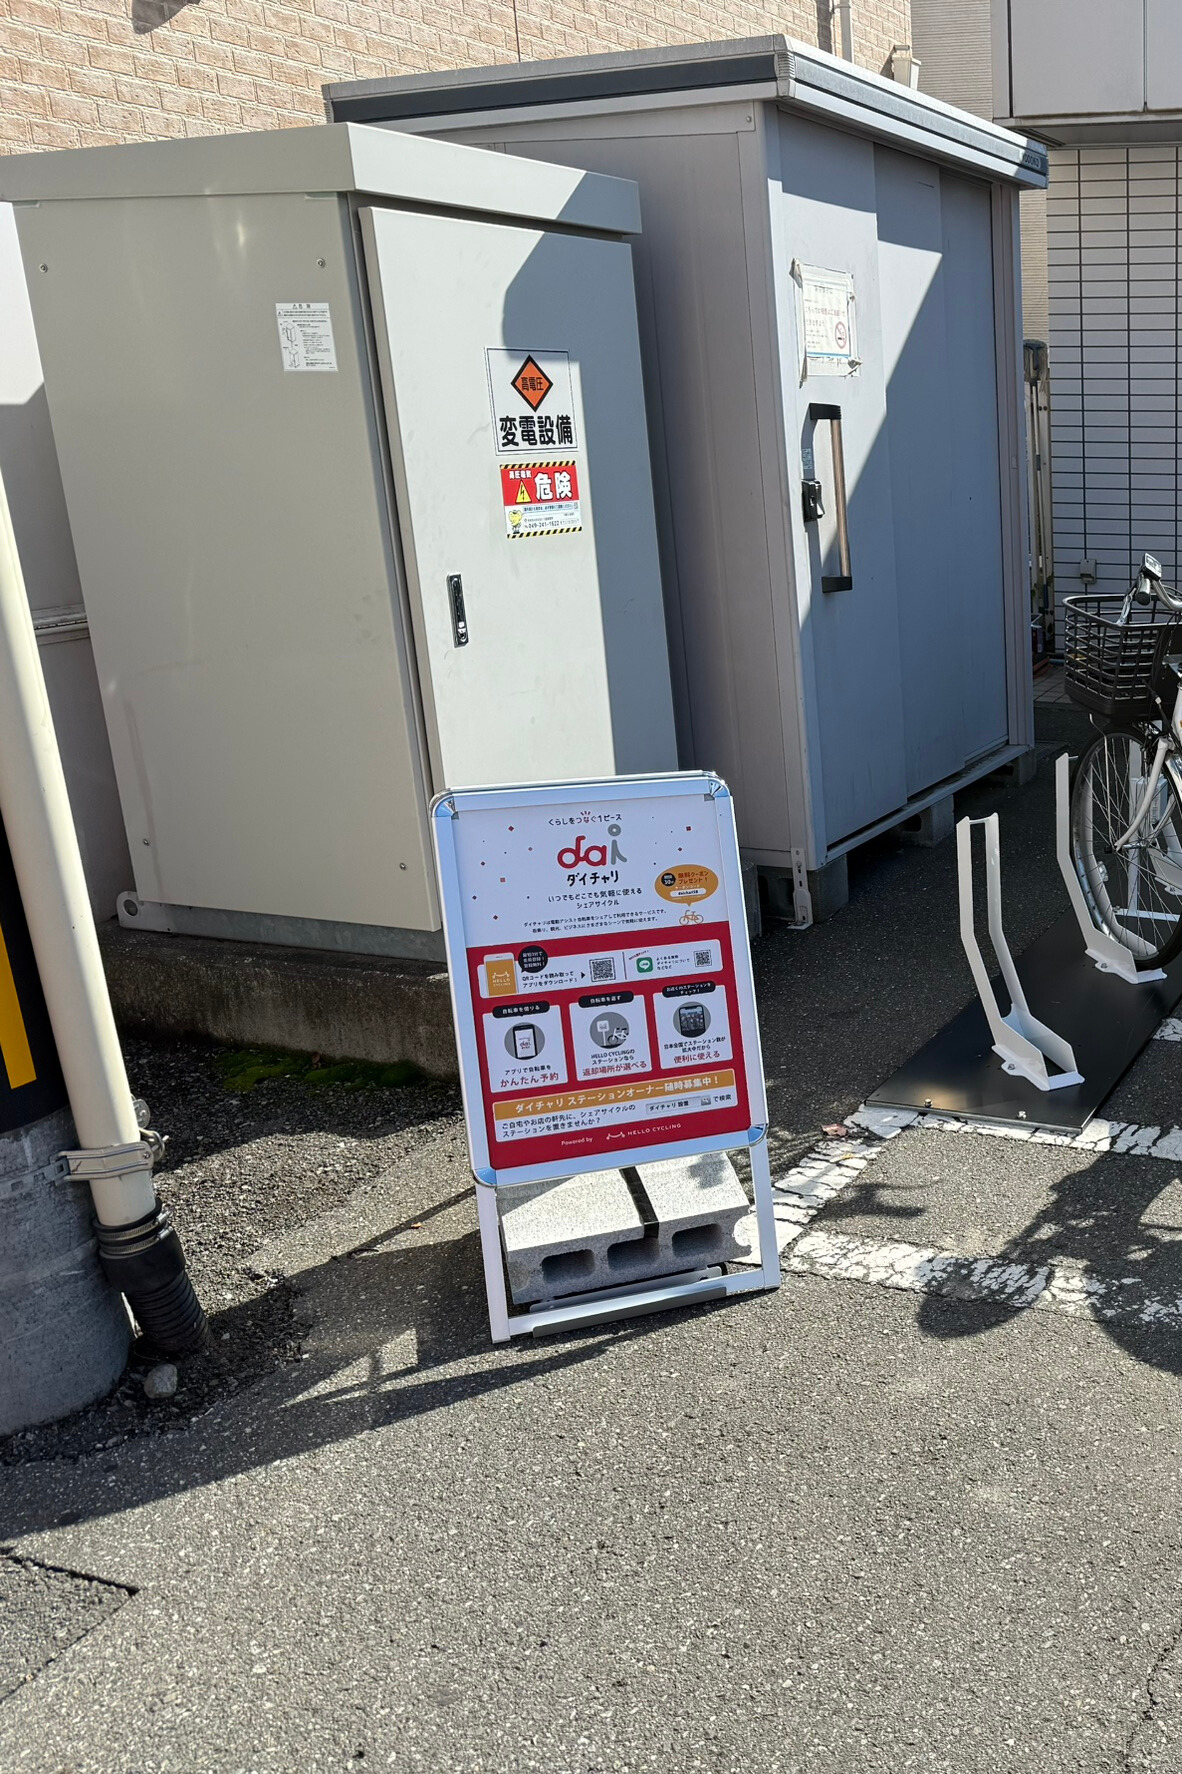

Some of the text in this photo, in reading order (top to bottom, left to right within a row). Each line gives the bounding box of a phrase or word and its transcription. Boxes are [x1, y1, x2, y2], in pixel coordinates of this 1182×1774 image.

[521, 376, 544, 391] 高電圧
[499, 414, 573, 447] 変電設備
[534, 469, 573, 501] 危険
[548, 812, 622, 826] くらしをつなぐ1ピース
[557, 824, 628, 869] dai
[566, 870, 619, 887] ダイチャリ
[548, 887, 643, 903] いつでもどこでも気軽に使える
[576, 899, 620, 909] シェアサイクル
[522, 971, 574, 982] QRコードを読み取って
[590, 1051, 607, 1059] HELLO
[673, 1051, 721, 1064] 便利に使える
[504, 1064, 551, 1075] アプリで自転車を
[582, 1060, 647, 1077] 返却場所が選べる
[500, 1072, 560, 1088] かんたん予約
[515, 1076, 719, 1113] ダイチャリ ステーションオーナー随時募集中！
[649, 1103, 676, 1112] ダイチャリ
[502, 1104, 636, 1130] ご自宅やお店の軒先に、シェアサイクルの
[503, 1117, 601, 1138] ステーションを置きませんか？
[627, 1123, 682, 1136] HELLO CYCLING
[561, 1136, 593, 1146] Powered by
